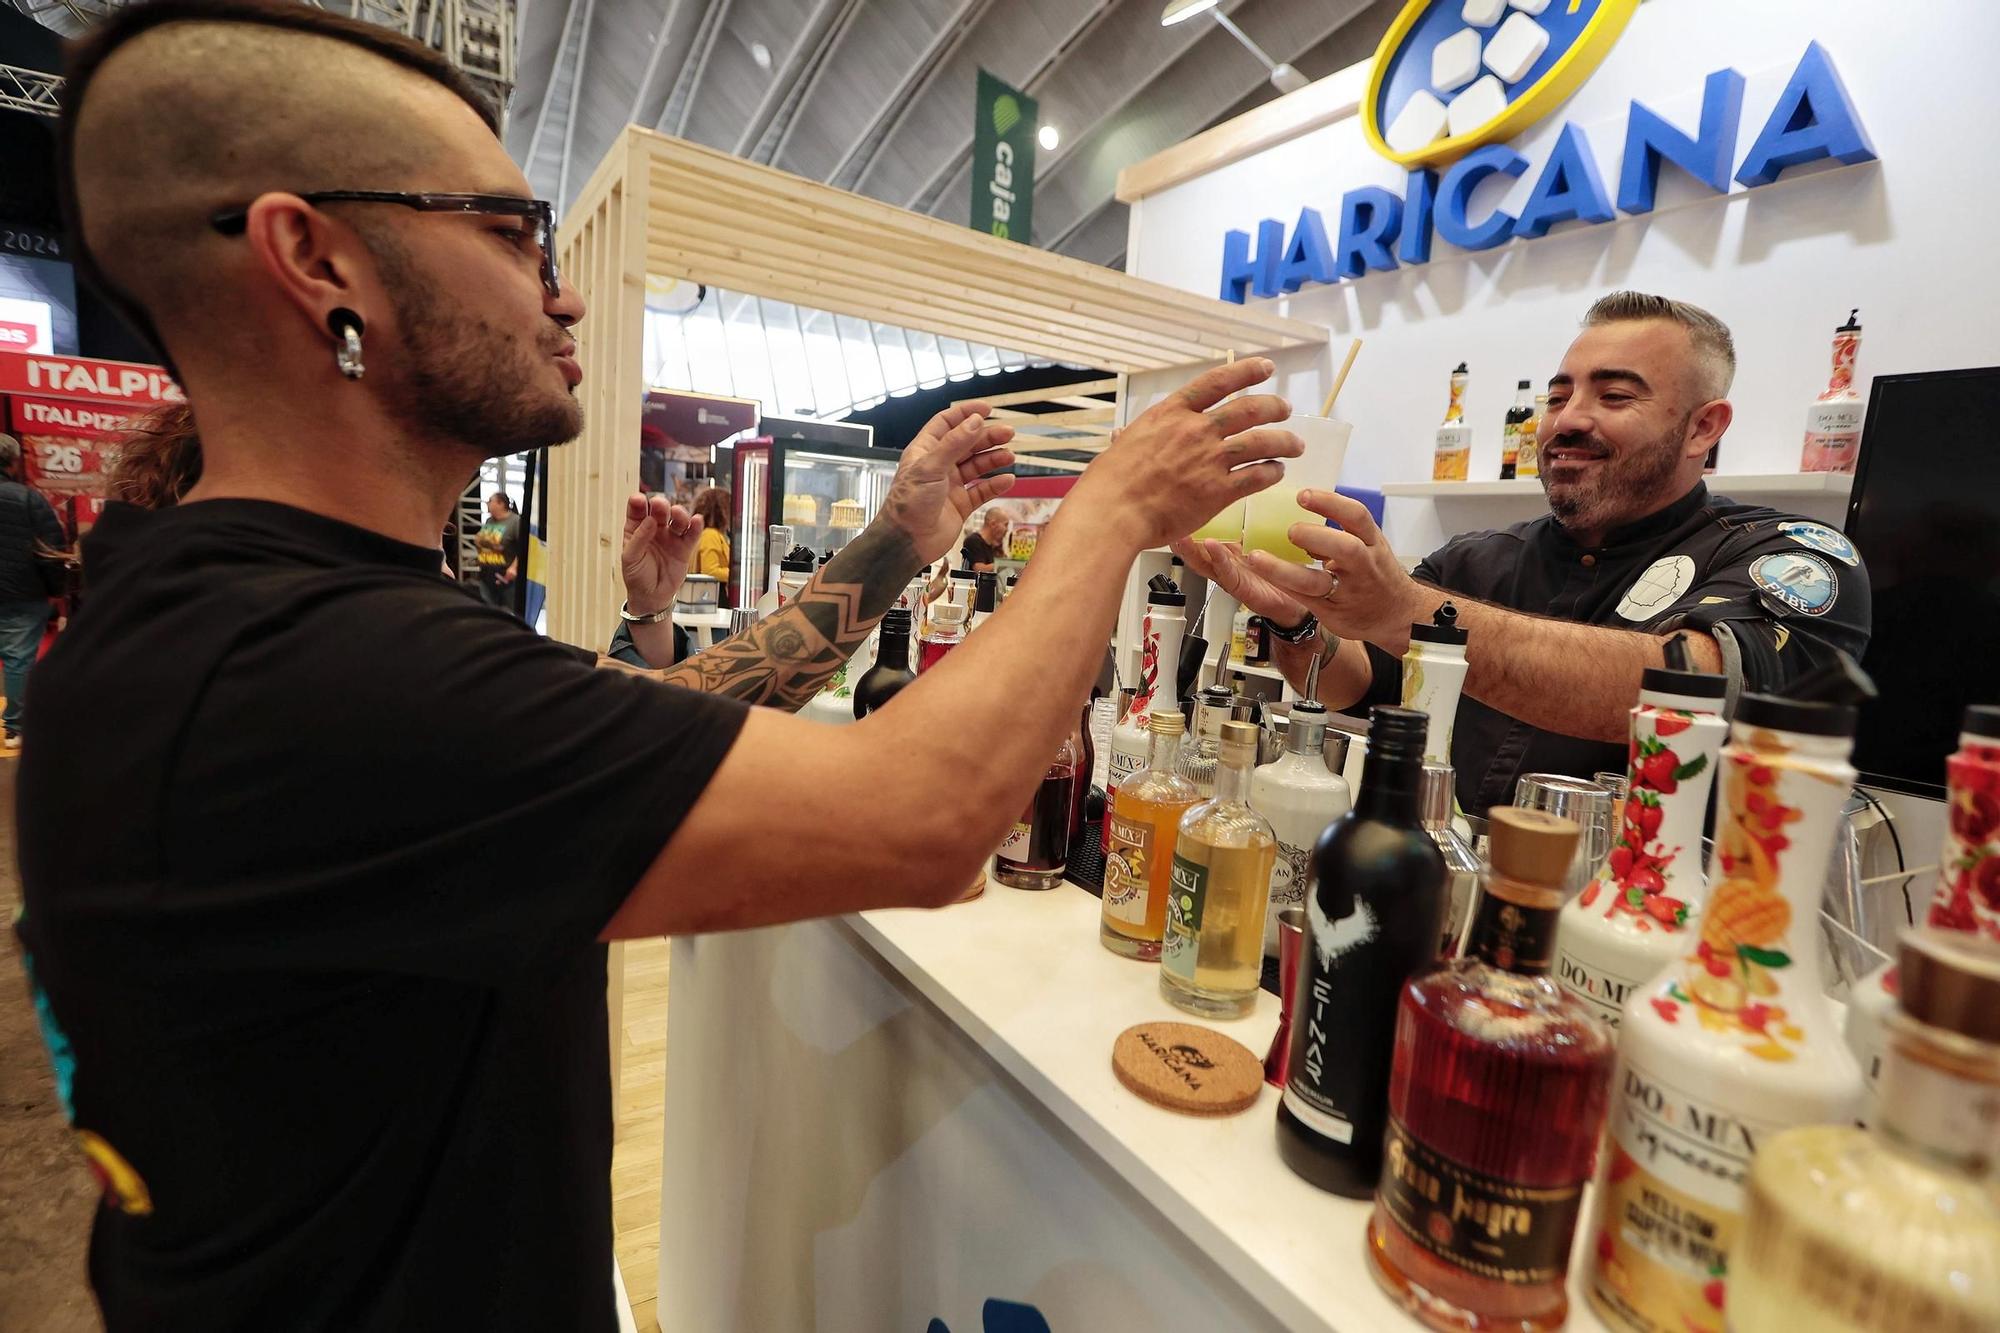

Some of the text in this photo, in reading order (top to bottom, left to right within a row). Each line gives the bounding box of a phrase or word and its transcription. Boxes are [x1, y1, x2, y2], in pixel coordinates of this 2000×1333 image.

[1220, 40, 1879, 305] HARICANA
[1765, 582, 1809, 613] FABE
[1304, 977, 1333, 1087] EINAR
